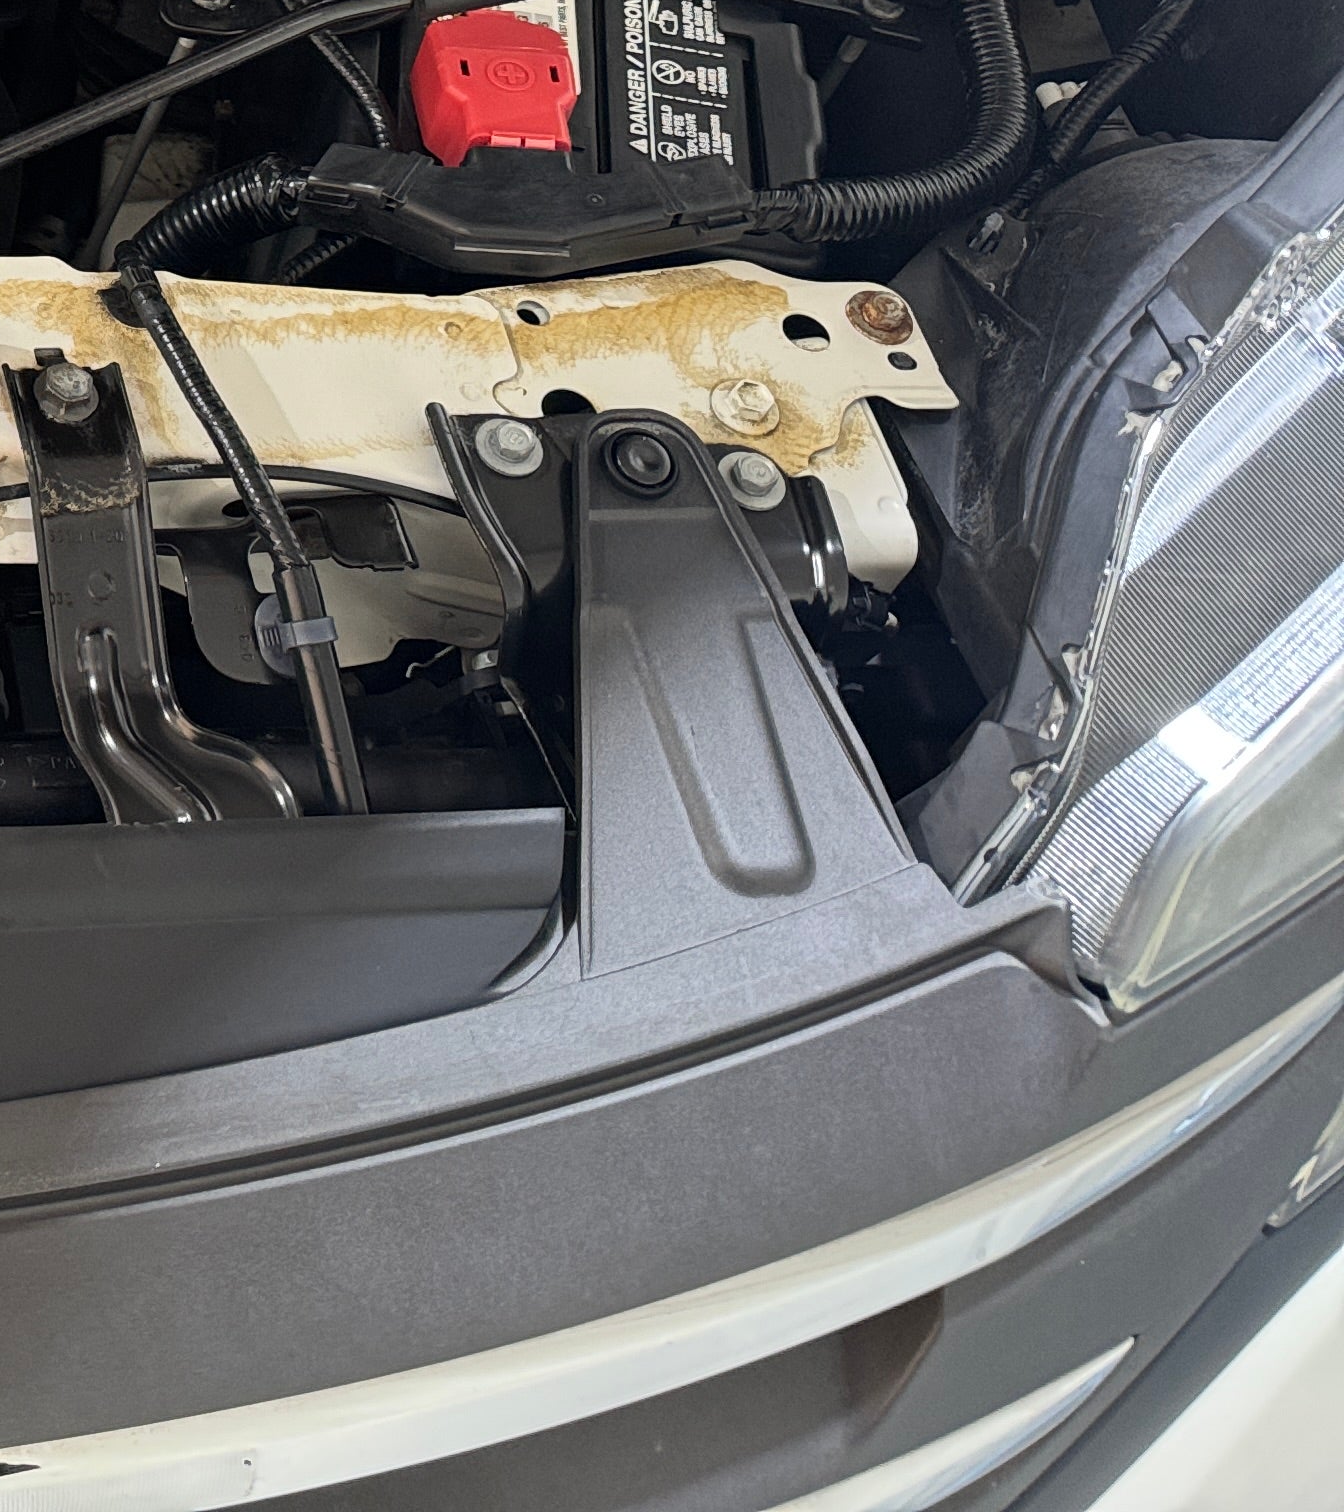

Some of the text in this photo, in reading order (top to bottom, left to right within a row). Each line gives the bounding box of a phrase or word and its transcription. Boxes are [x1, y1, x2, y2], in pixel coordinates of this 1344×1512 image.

[684, 70, 697, 84] NO
[627, 68, 648, 136] DANGER
[661, 105, 673, 135] SHIELD
[673, 114, 685, 137] EYES
